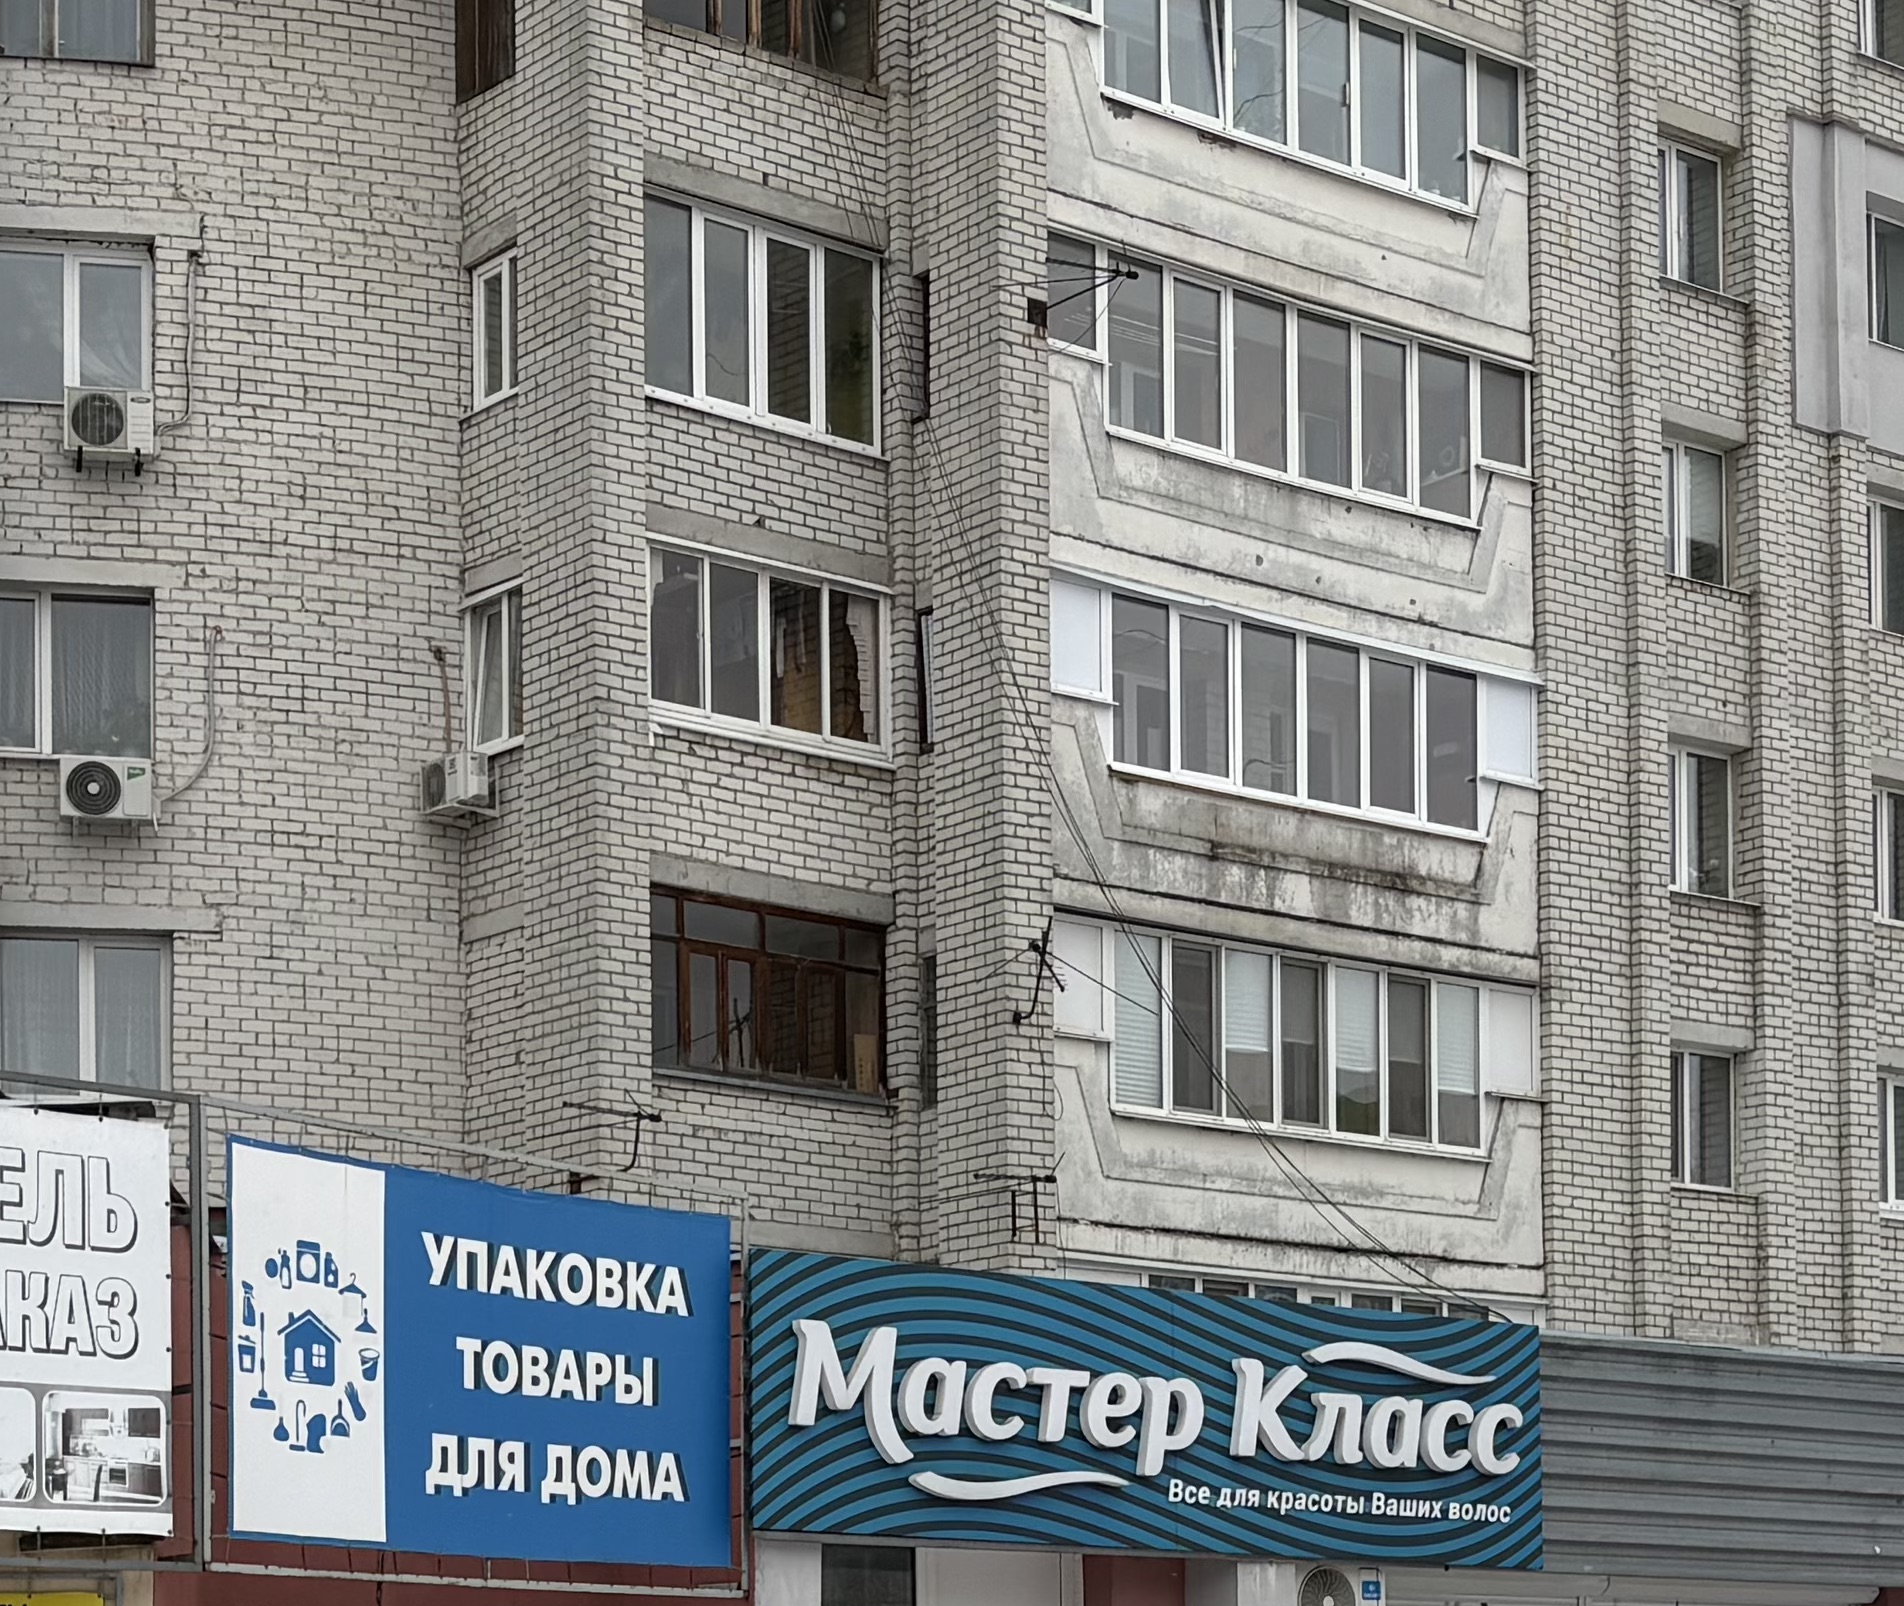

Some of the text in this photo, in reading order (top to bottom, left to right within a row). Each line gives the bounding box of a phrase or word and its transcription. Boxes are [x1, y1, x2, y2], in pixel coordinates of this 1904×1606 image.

[421, 1231, 696, 1318] УПАКОВКА
[455, 1336, 659, 1408] ТОВАРЫ
[787, 1317, 1524, 1478] Мастер Класс
[424, 1433, 689, 1506] ДЛЯ ДОМА
[1168, 1478, 1512, 1524] Все для красоты Ваших волос
